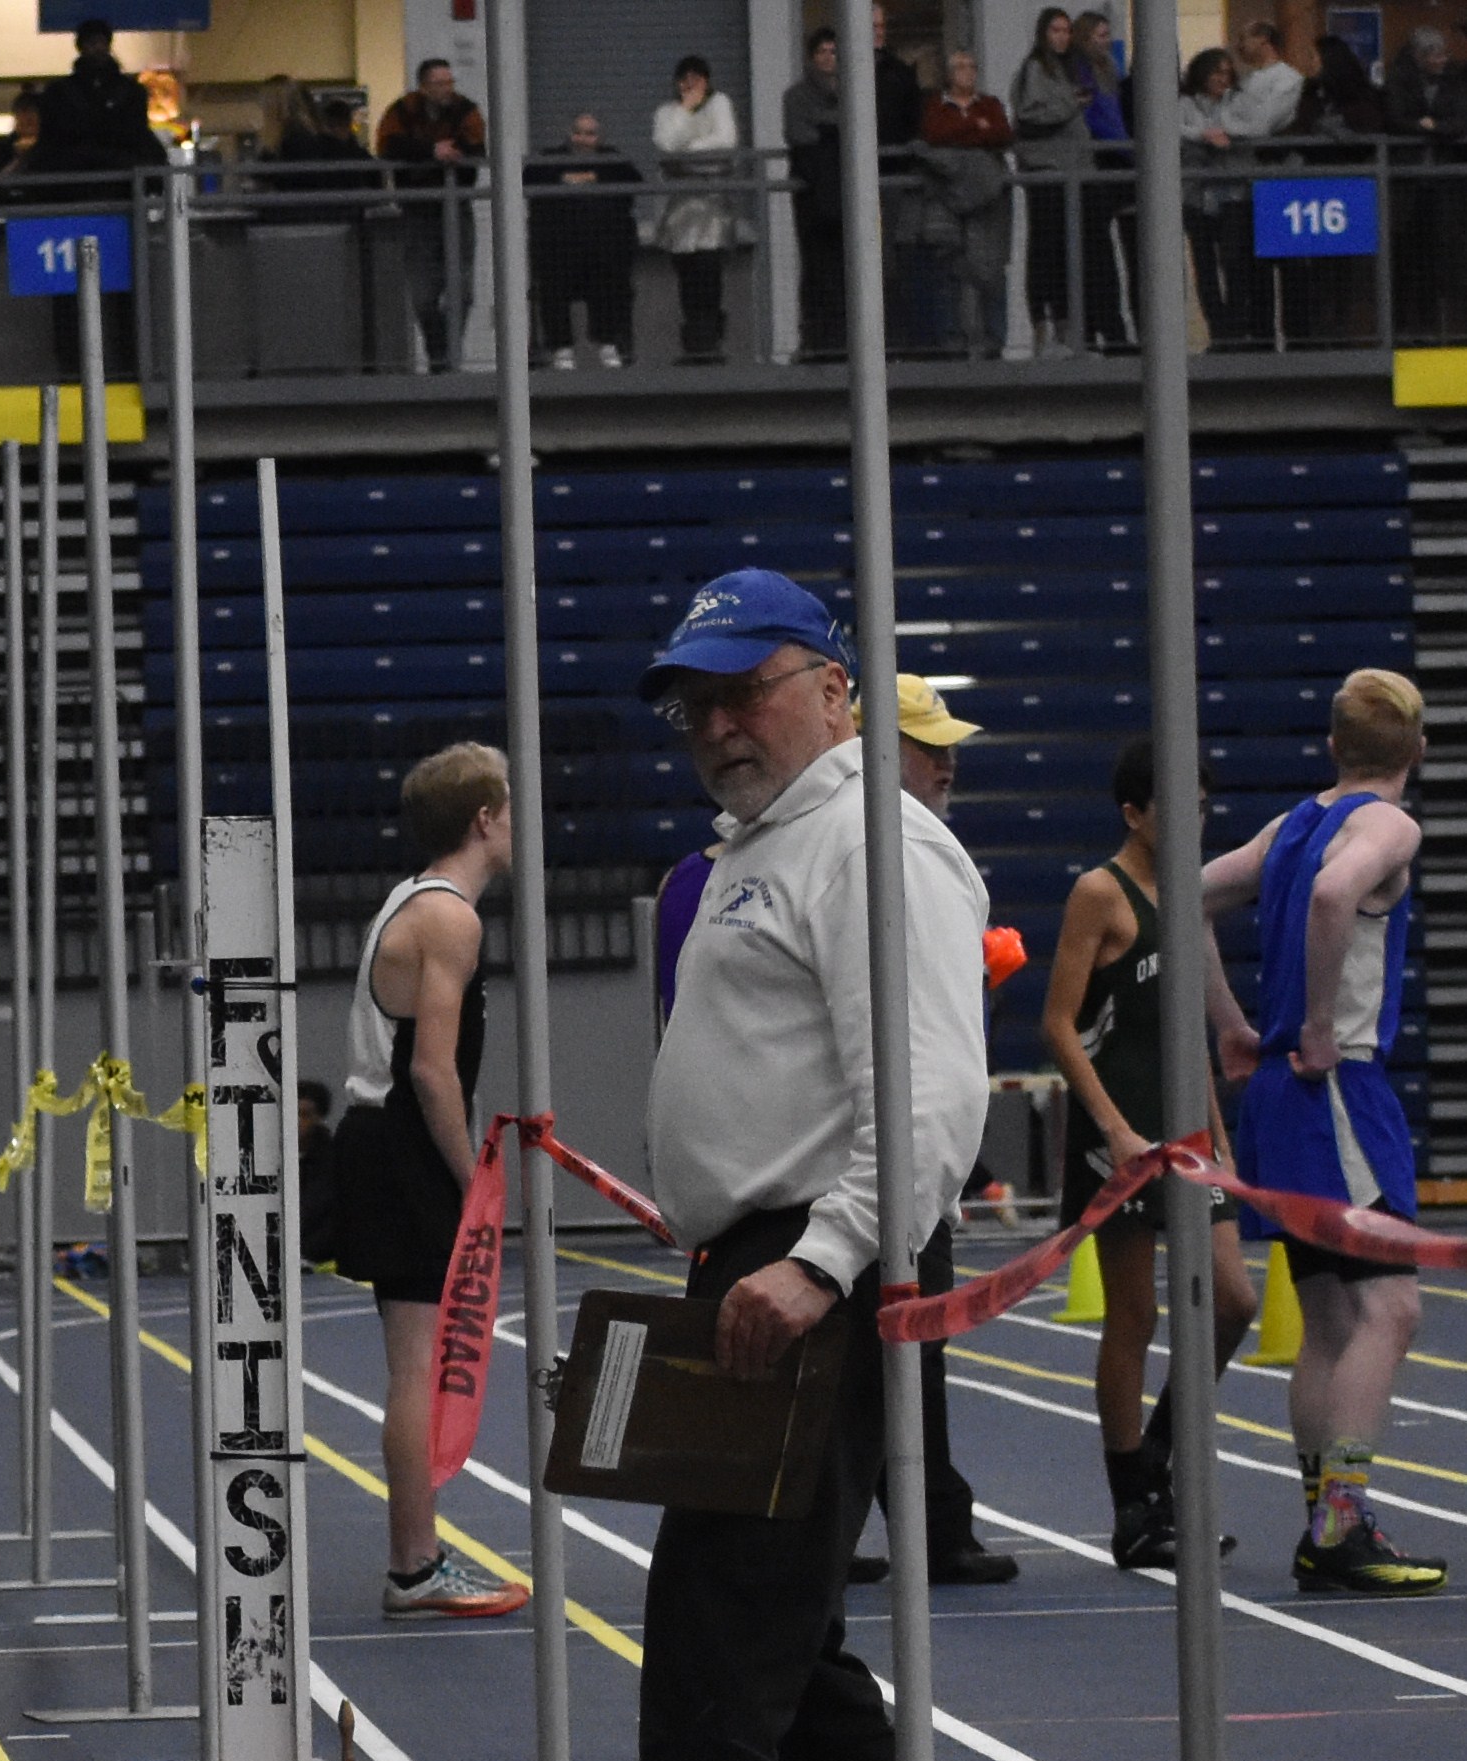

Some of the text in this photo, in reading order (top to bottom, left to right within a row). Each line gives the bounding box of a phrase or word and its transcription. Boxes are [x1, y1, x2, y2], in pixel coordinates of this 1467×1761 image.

[1282, 198, 1349, 236] 116
[37, 237, 87, 274] 11
[209, 957, 288, 1707] FINISH
